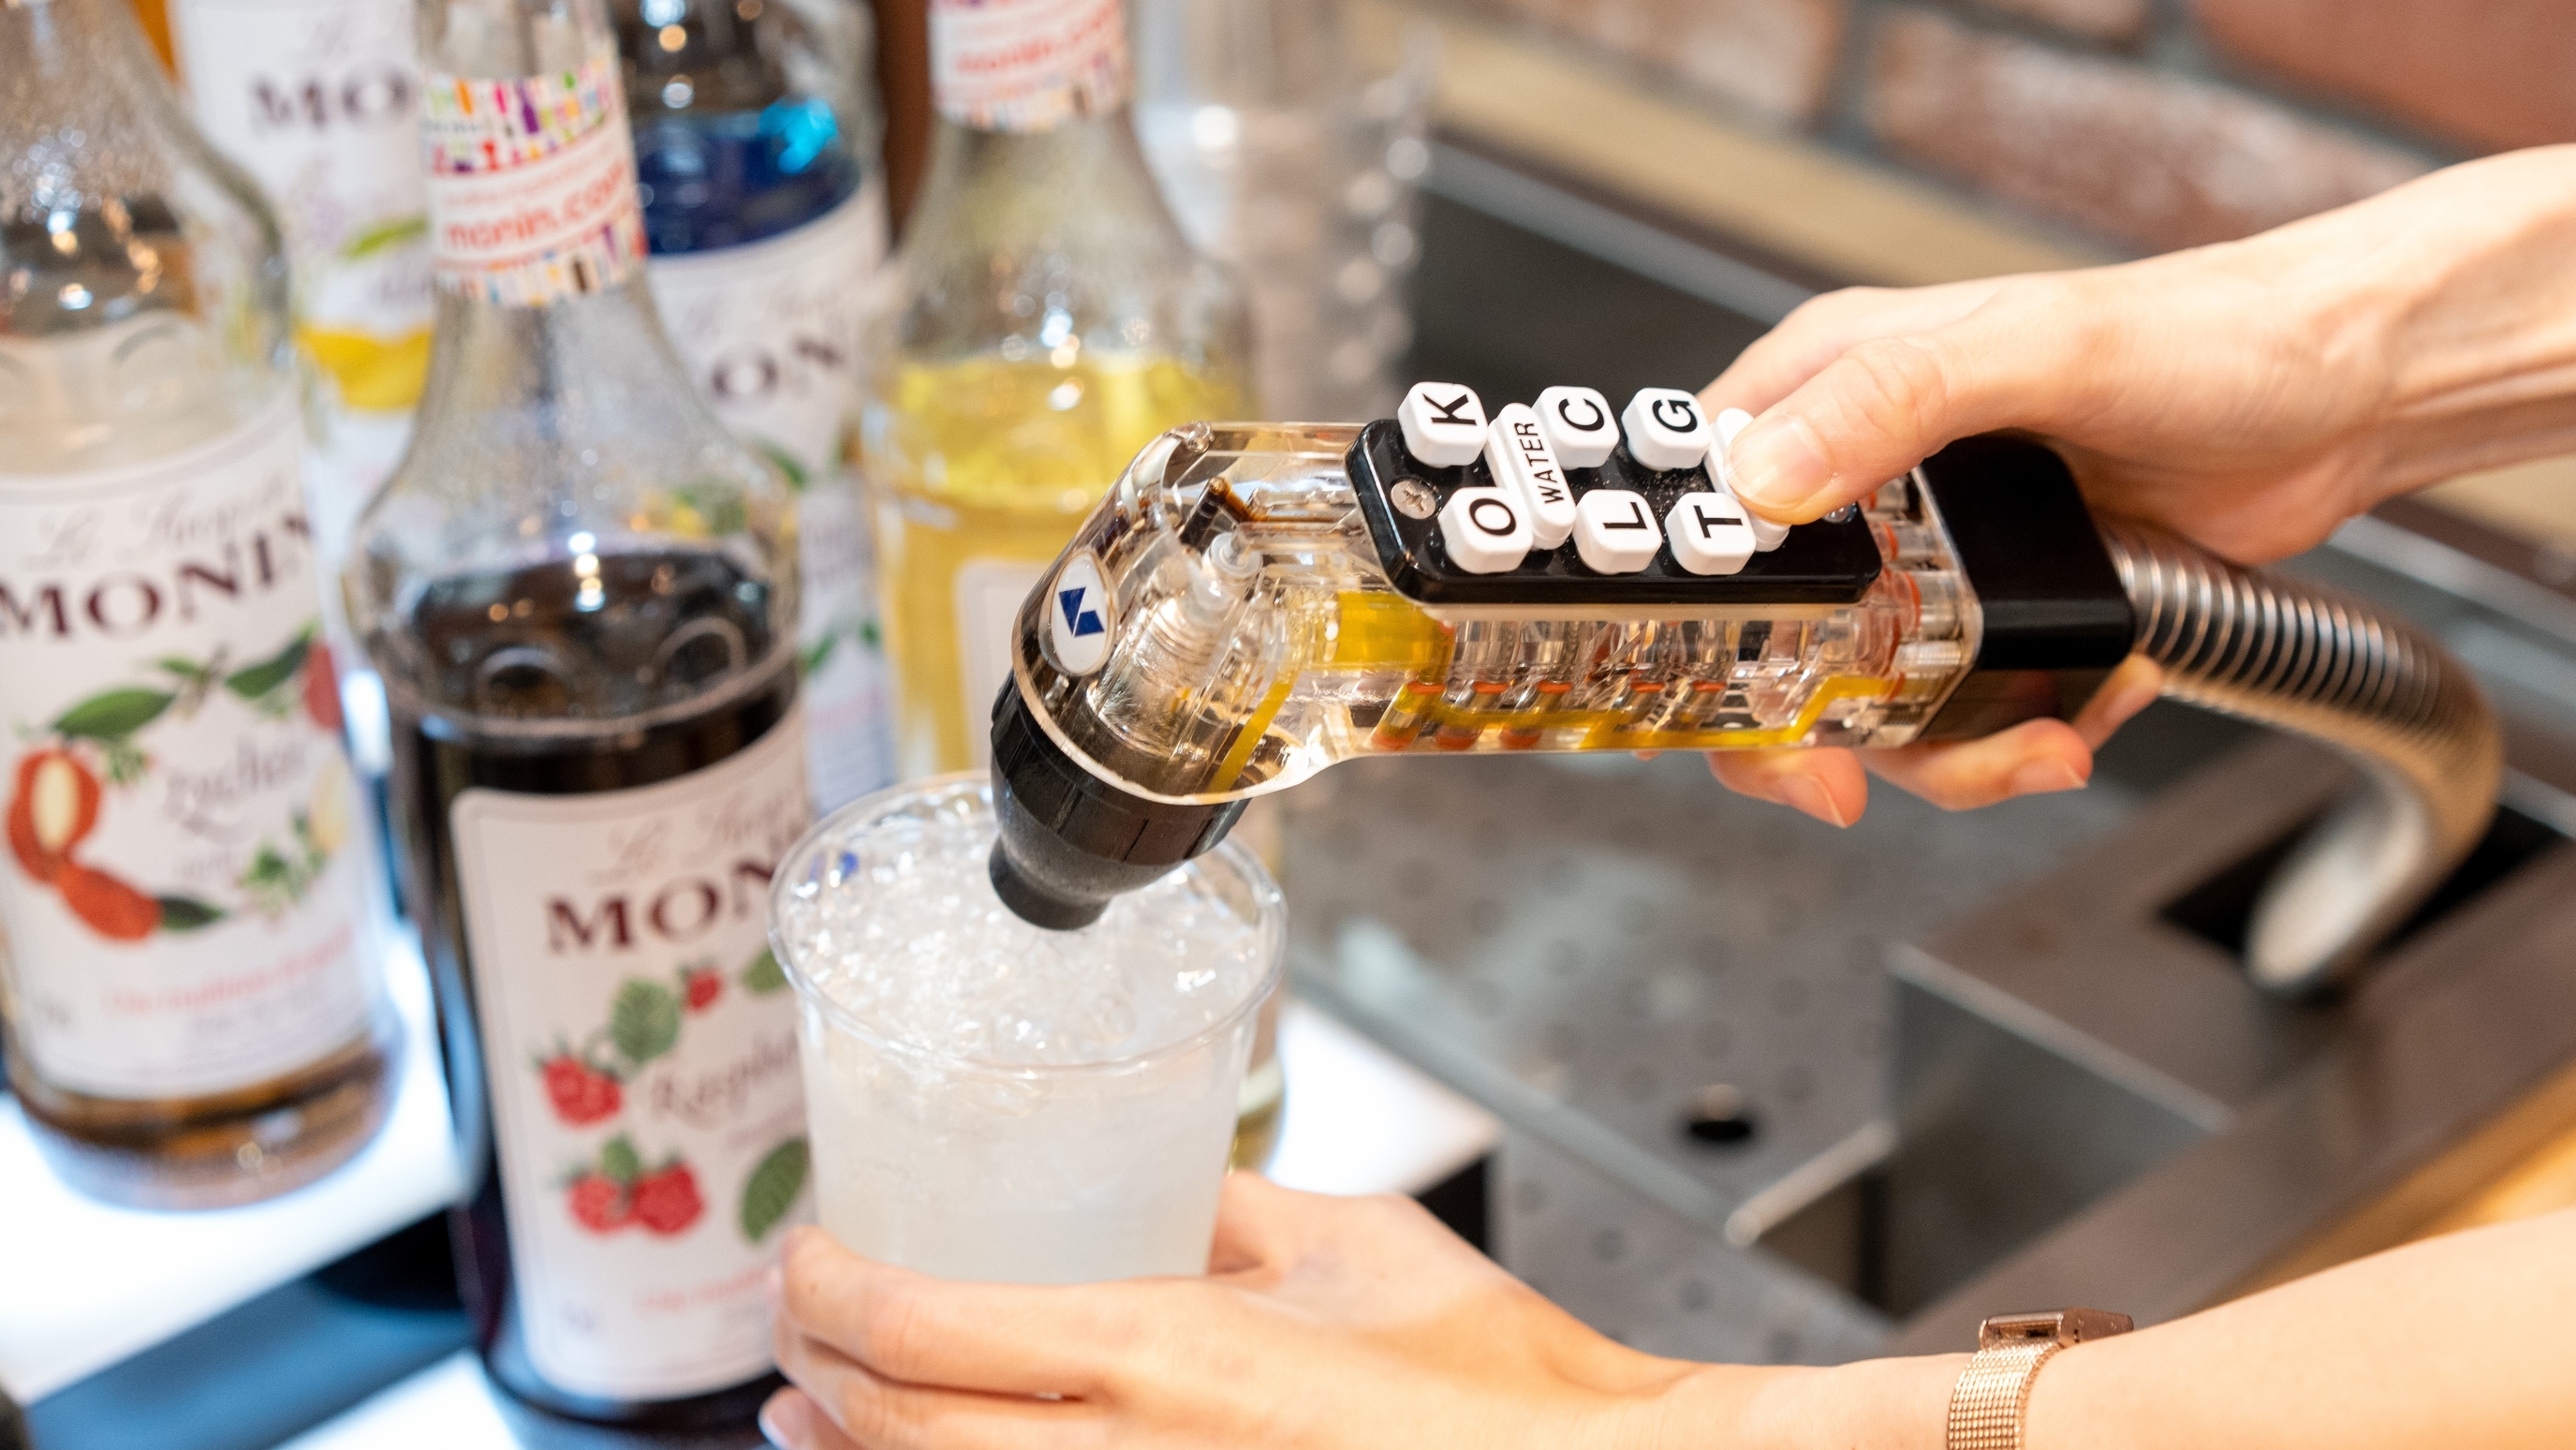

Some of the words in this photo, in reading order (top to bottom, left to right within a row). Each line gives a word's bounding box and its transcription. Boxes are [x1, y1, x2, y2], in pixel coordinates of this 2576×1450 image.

[1423, 392, 1477, 427] K
[1558, 398, 1605, 432] C
[1652, 398, 1699, 434] G
[1513, 421, 1566, 505] WATER
[1469, 497, 1517, 537] O
[1602, 501, 1649, 531] L
[1693, 504, 1744, 540] T
